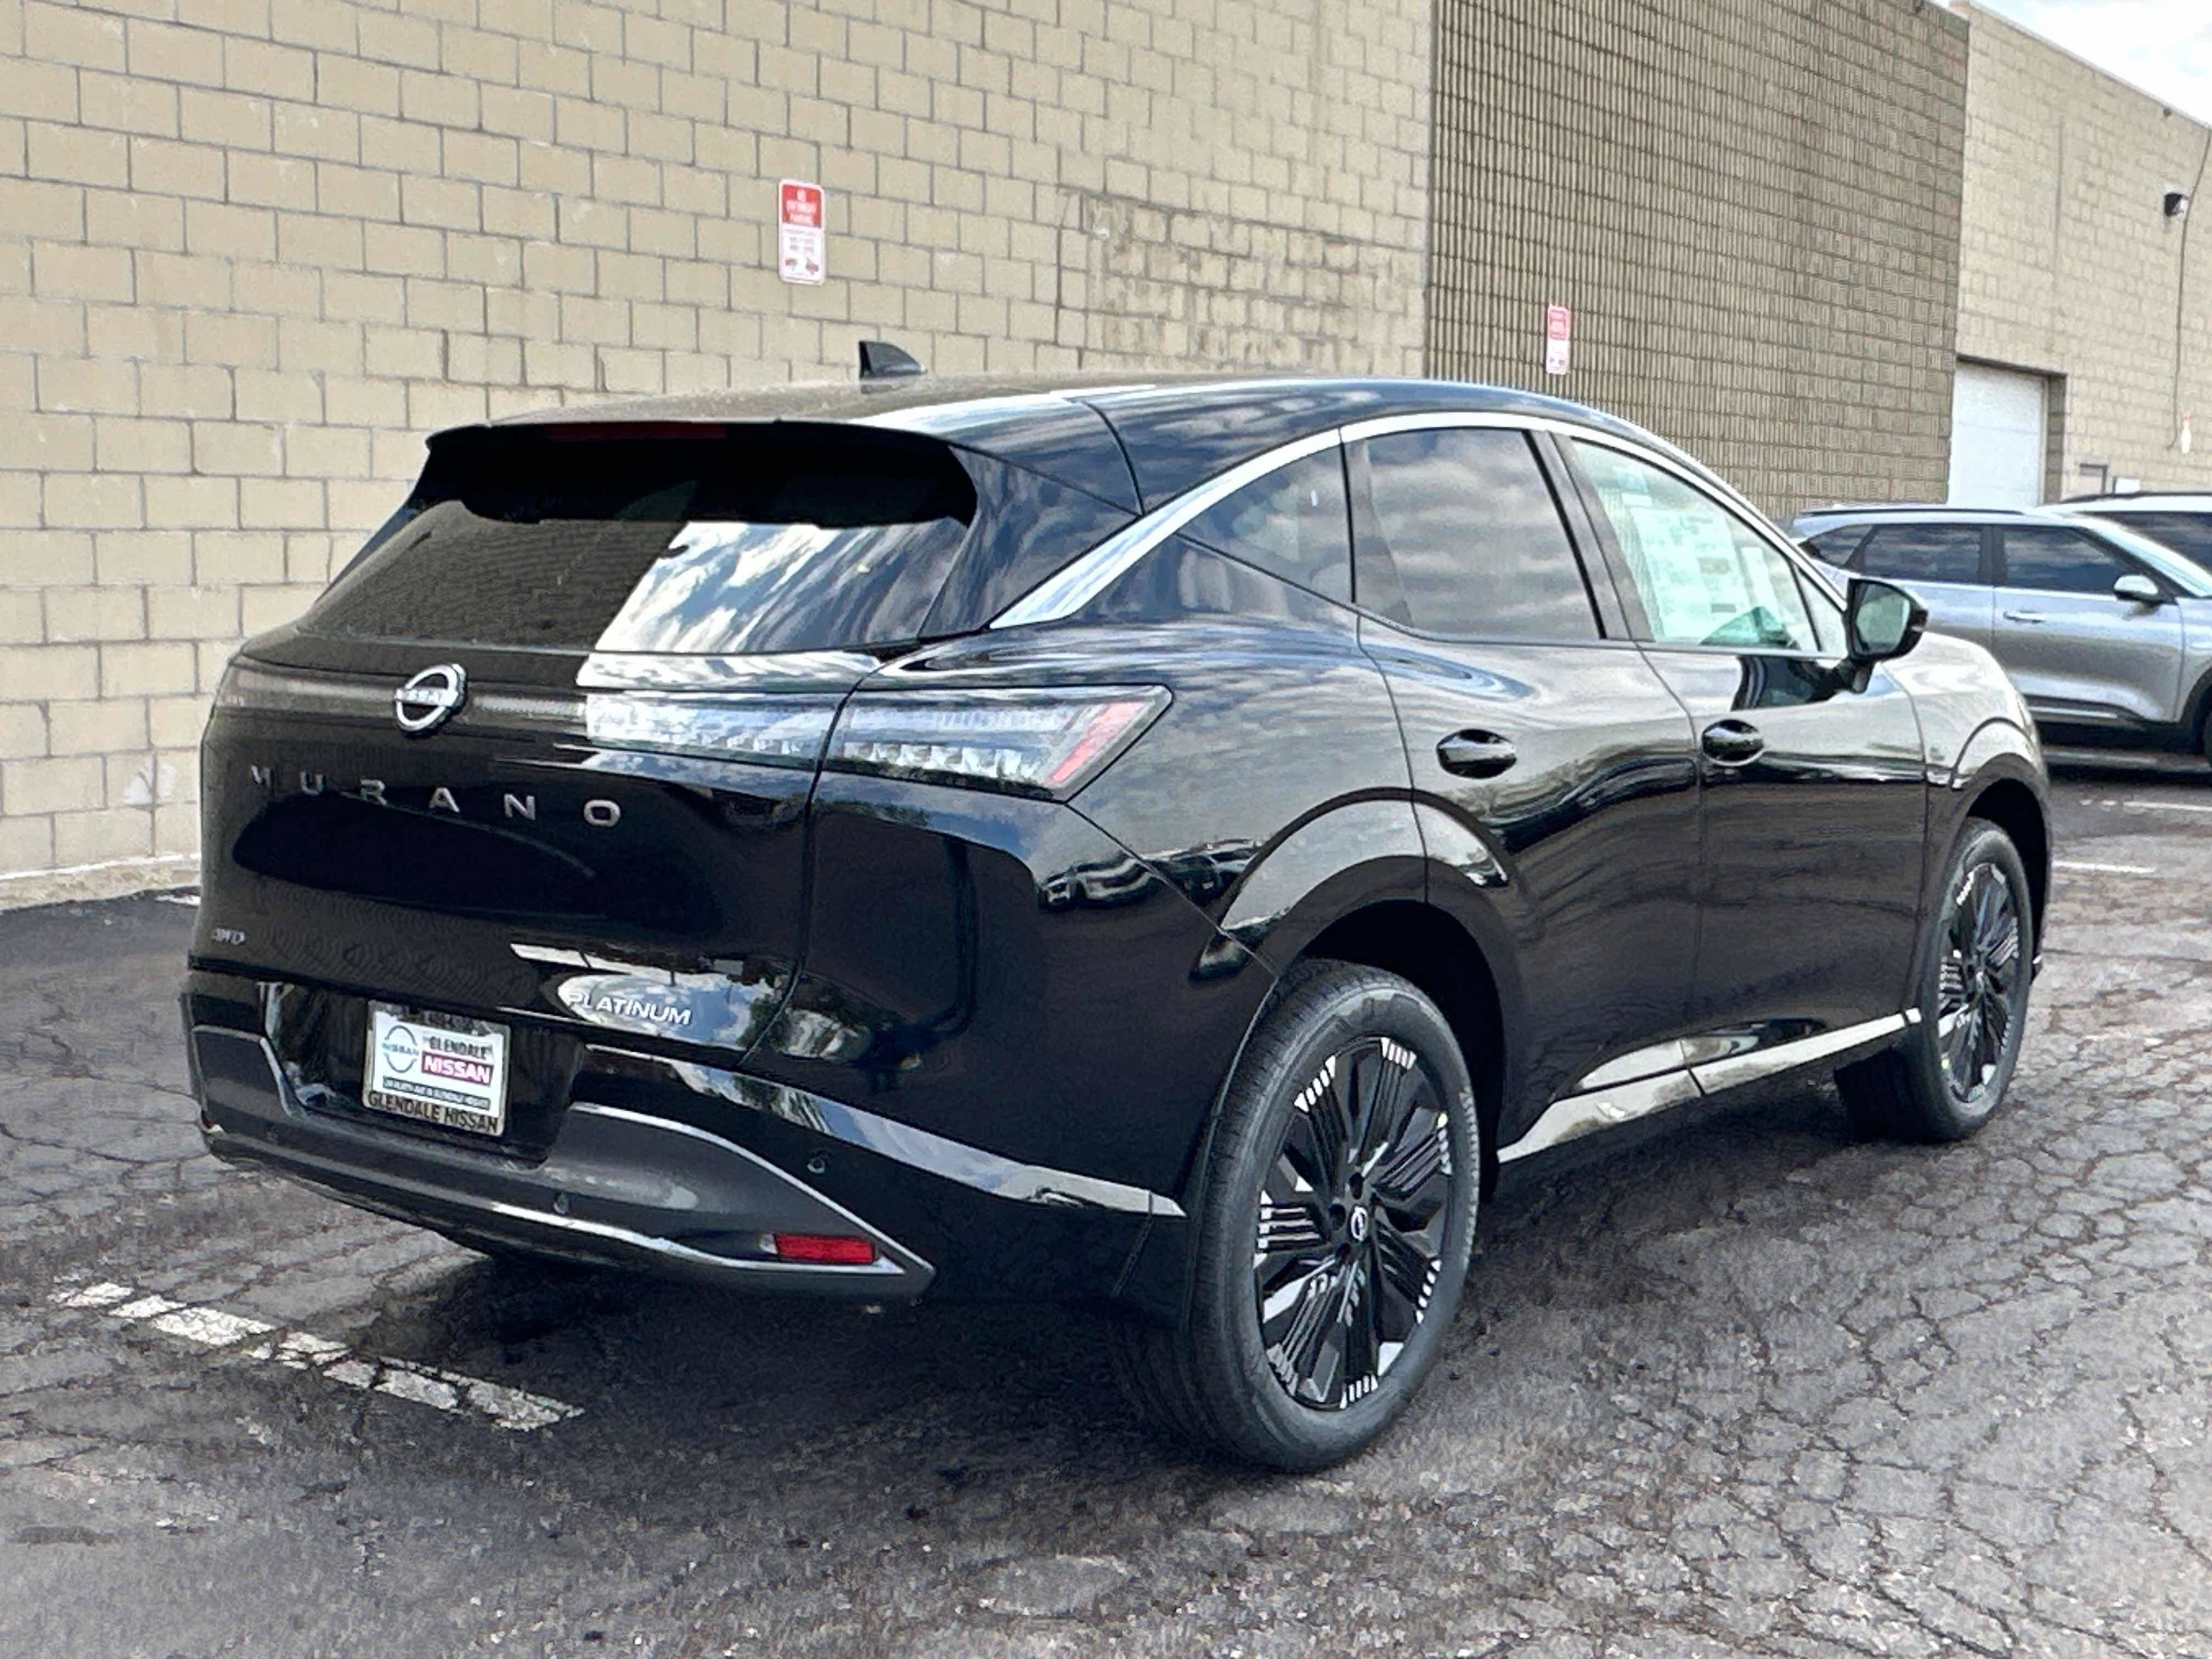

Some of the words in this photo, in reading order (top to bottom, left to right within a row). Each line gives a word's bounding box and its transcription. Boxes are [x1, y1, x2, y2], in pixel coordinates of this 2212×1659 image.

[251, 764, 622, 828] MURANO
[563, 993, 692, 1025] PLATINUM
[424, 1054, 490, 1084] NISSAN
[368, 1090, 441, 1120] GLENDALE
[444, 1107, 498, 1134] NISSAN
